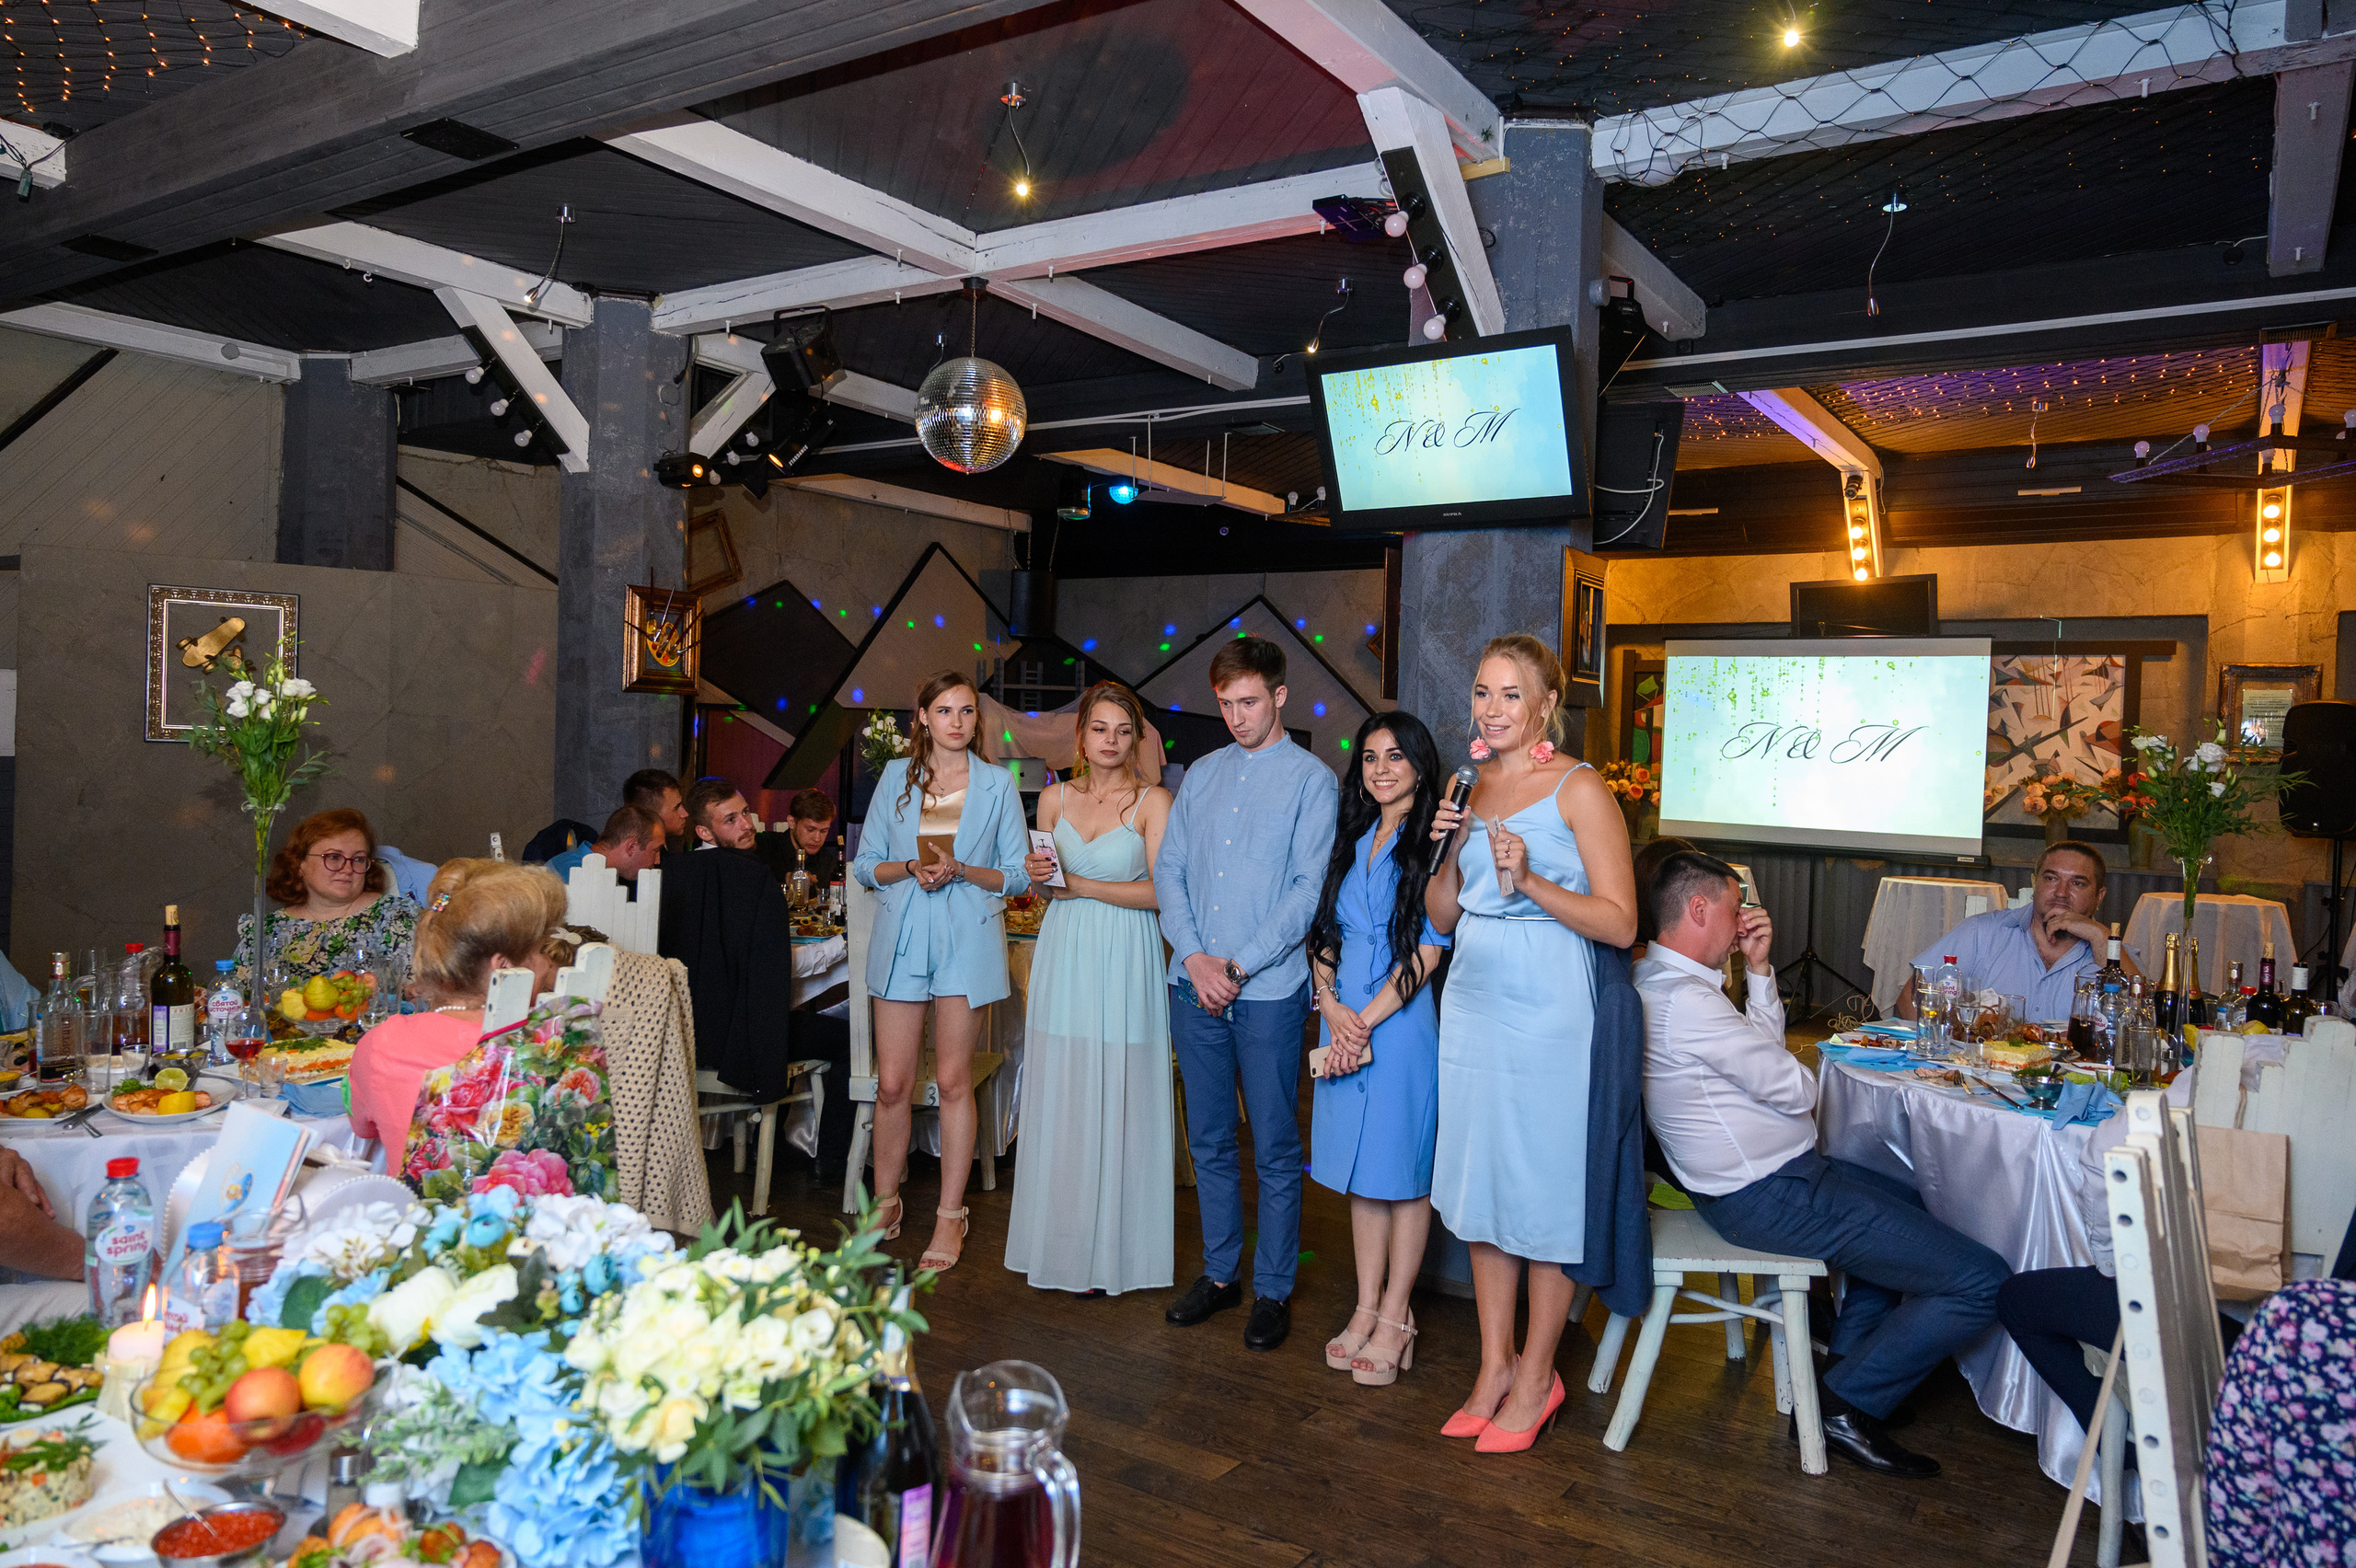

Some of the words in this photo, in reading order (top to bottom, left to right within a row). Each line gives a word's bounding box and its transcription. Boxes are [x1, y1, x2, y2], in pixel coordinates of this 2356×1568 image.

[1453, 408, 1520, 448] M
[1830, 724, 1930, 764] M
[107, 1241, 148, 1257] spring
[111, 1231, 145, 1245] saint
